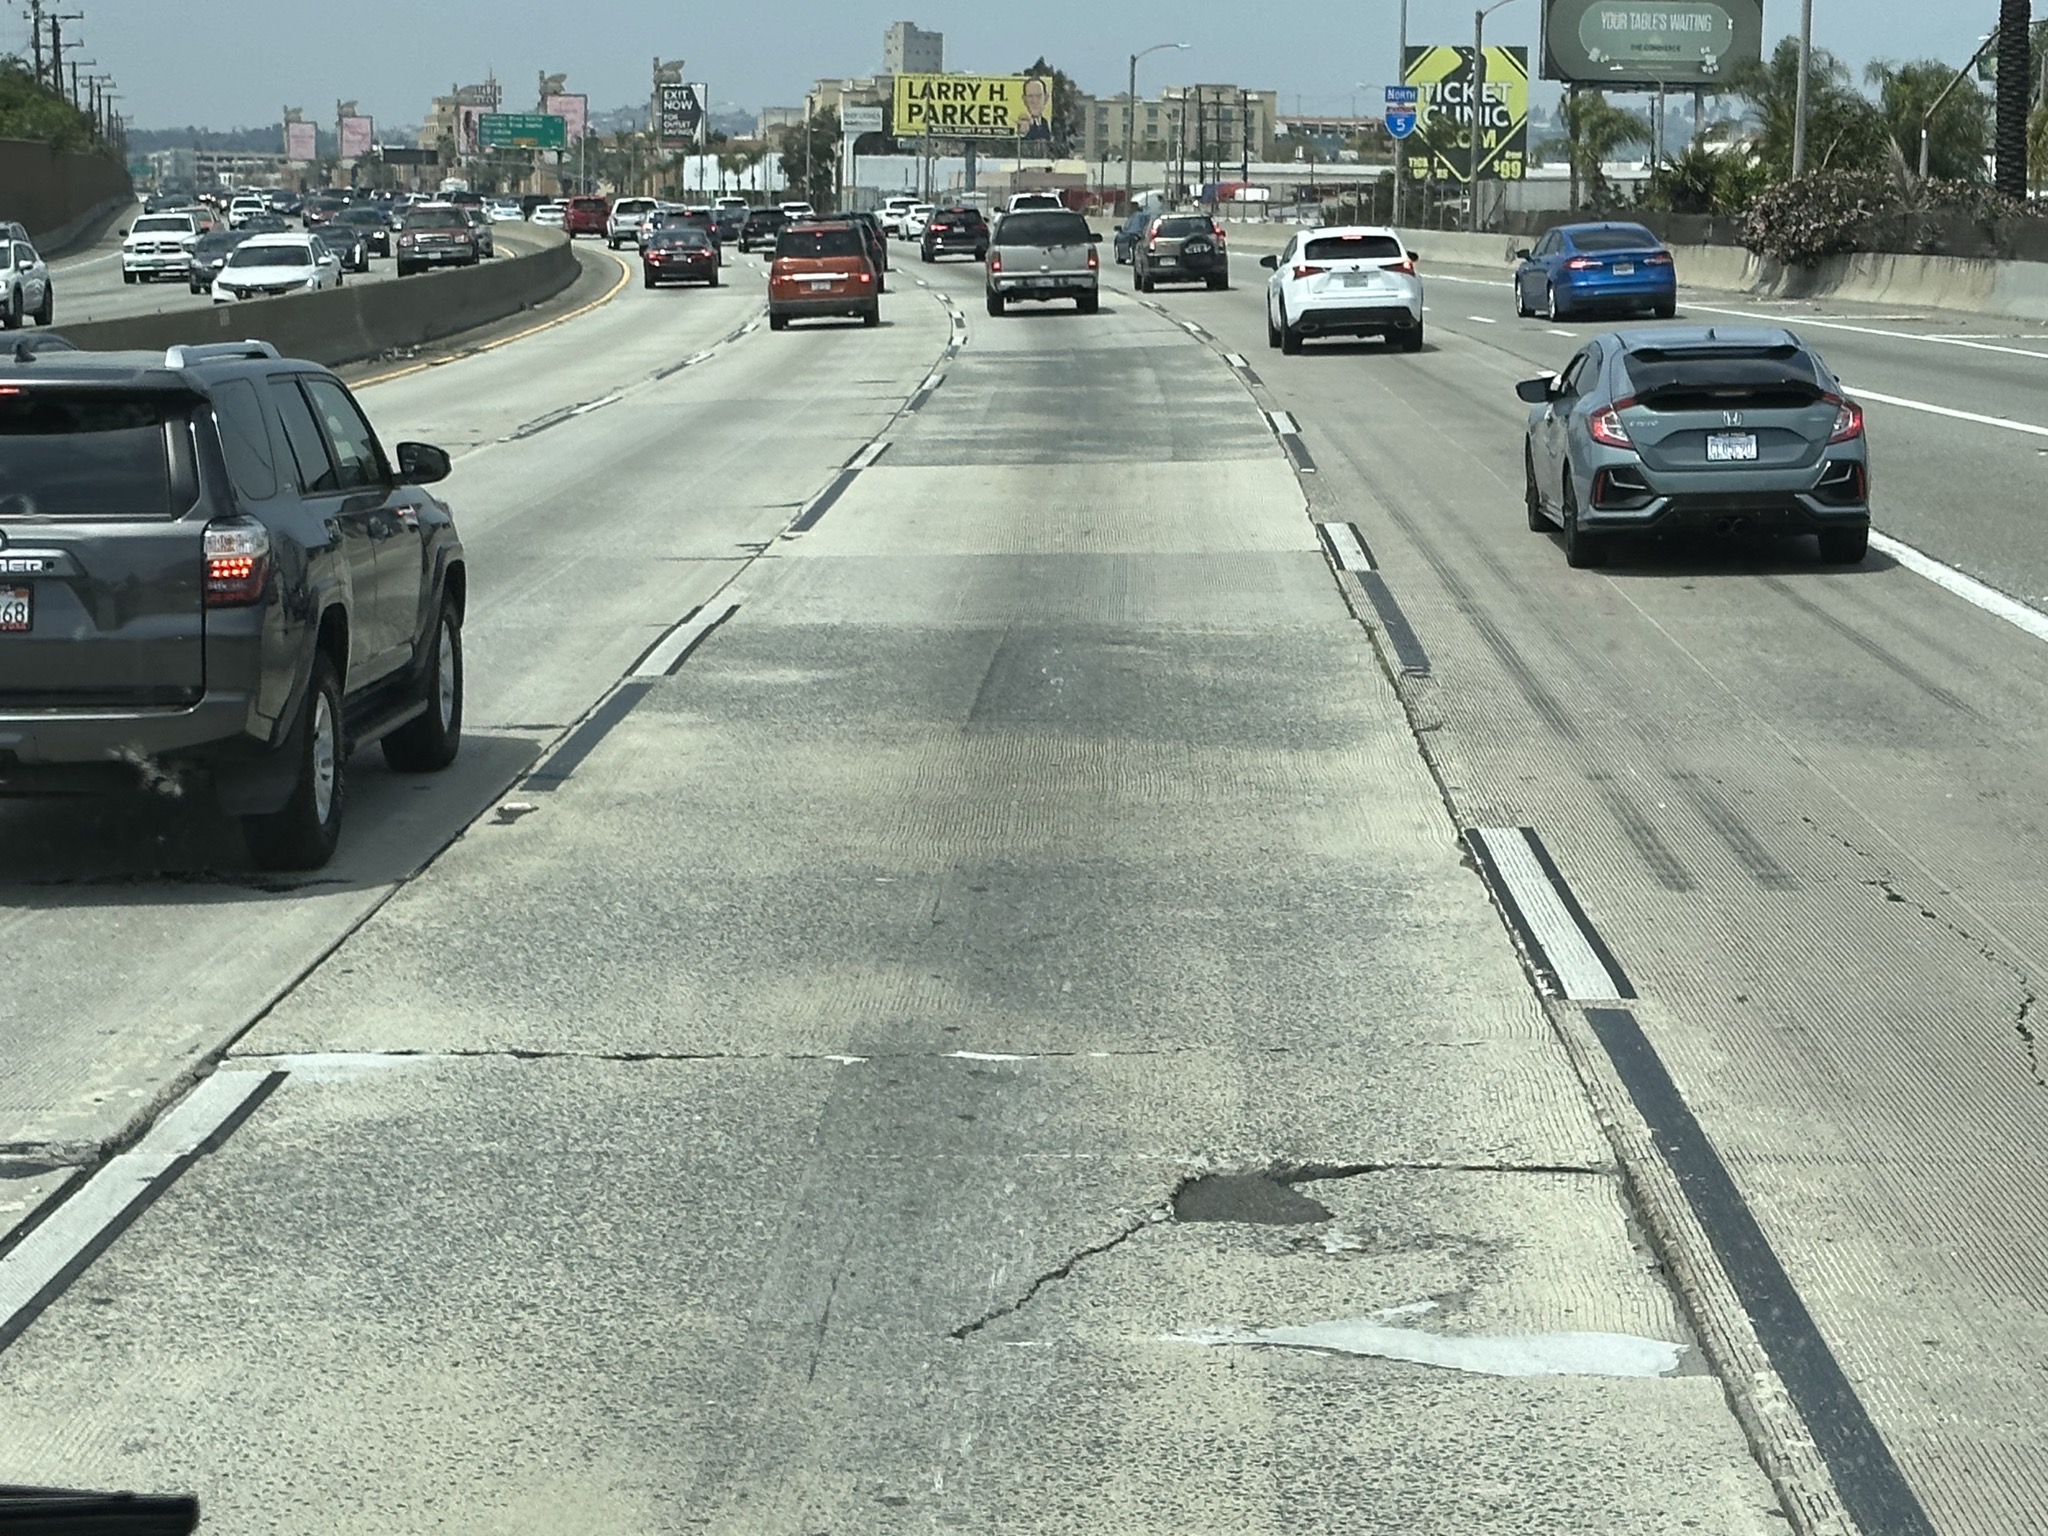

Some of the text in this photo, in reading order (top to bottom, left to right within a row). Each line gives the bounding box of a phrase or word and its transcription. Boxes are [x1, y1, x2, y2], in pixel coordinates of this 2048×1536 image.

[1601, 11, 1712, 32] YOUR TABLE'S WAITING
[664, 90, 688, 100] EXIT
[908, 81, 1008, 101] LARRY H.
[1387, 89, 1416, 100] NORTH
[1421, 82, 1512, 104] TICKET
[664, 100, 693, 110] NOW
[908, 104, 1008, 126] PARKER
[1396, 118, 1406, 132] 5
[0, 601, 25, 624] 68
